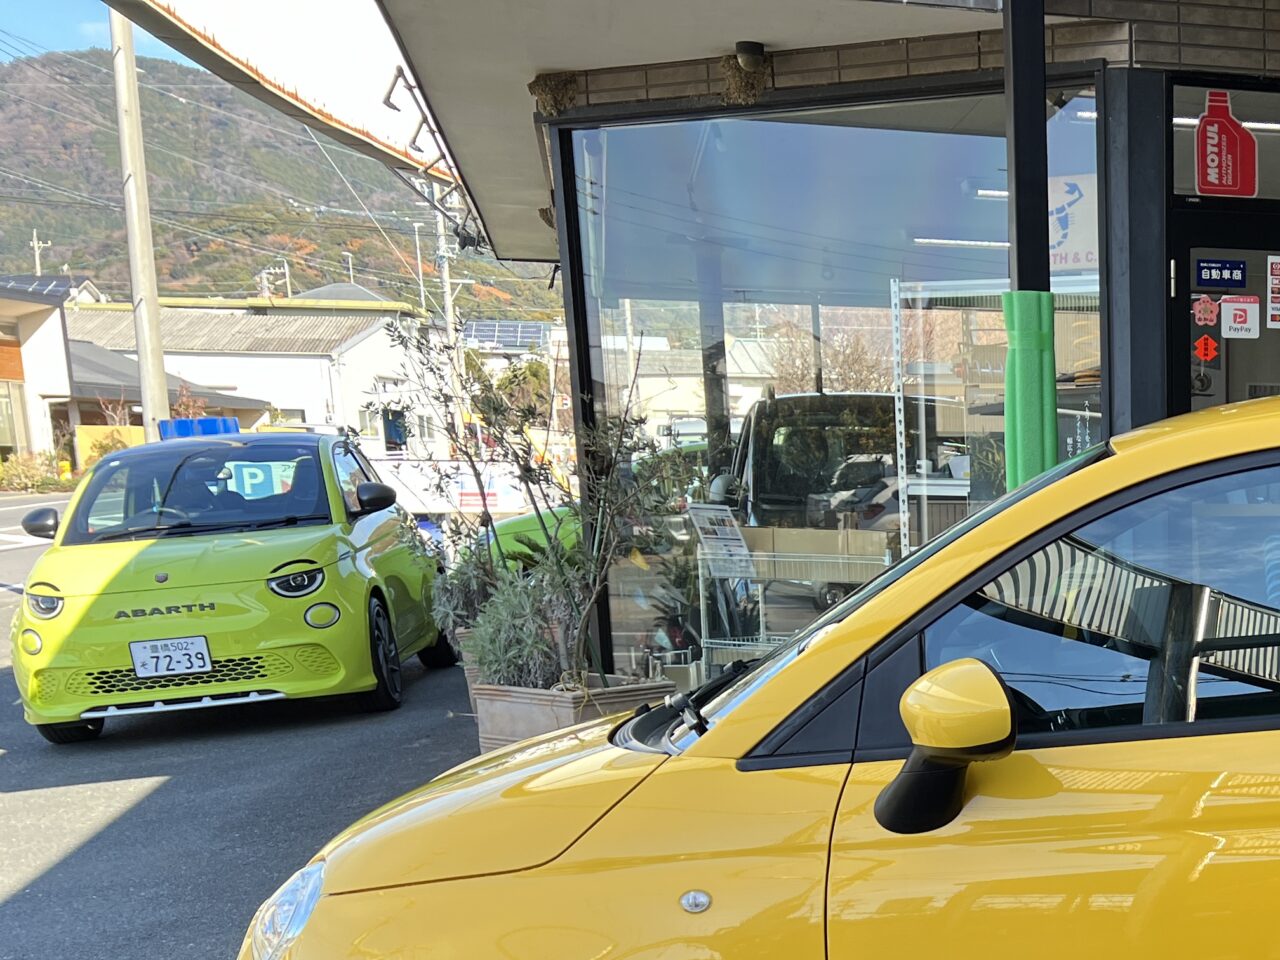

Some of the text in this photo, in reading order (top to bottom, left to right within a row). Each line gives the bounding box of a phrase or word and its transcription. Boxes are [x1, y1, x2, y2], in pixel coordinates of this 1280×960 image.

[1206, 123, 1219, 185] MOTUL
[1072, 252, 1081, 263] &
[1201, 268, 1242, 280] 自動車商
[1228, 326, 1252, 334] PayPay
[242, 467, 265, 494] P
[113, 602, 216, 619] ABARTH
[150, 651, 207, 673] 72-39
